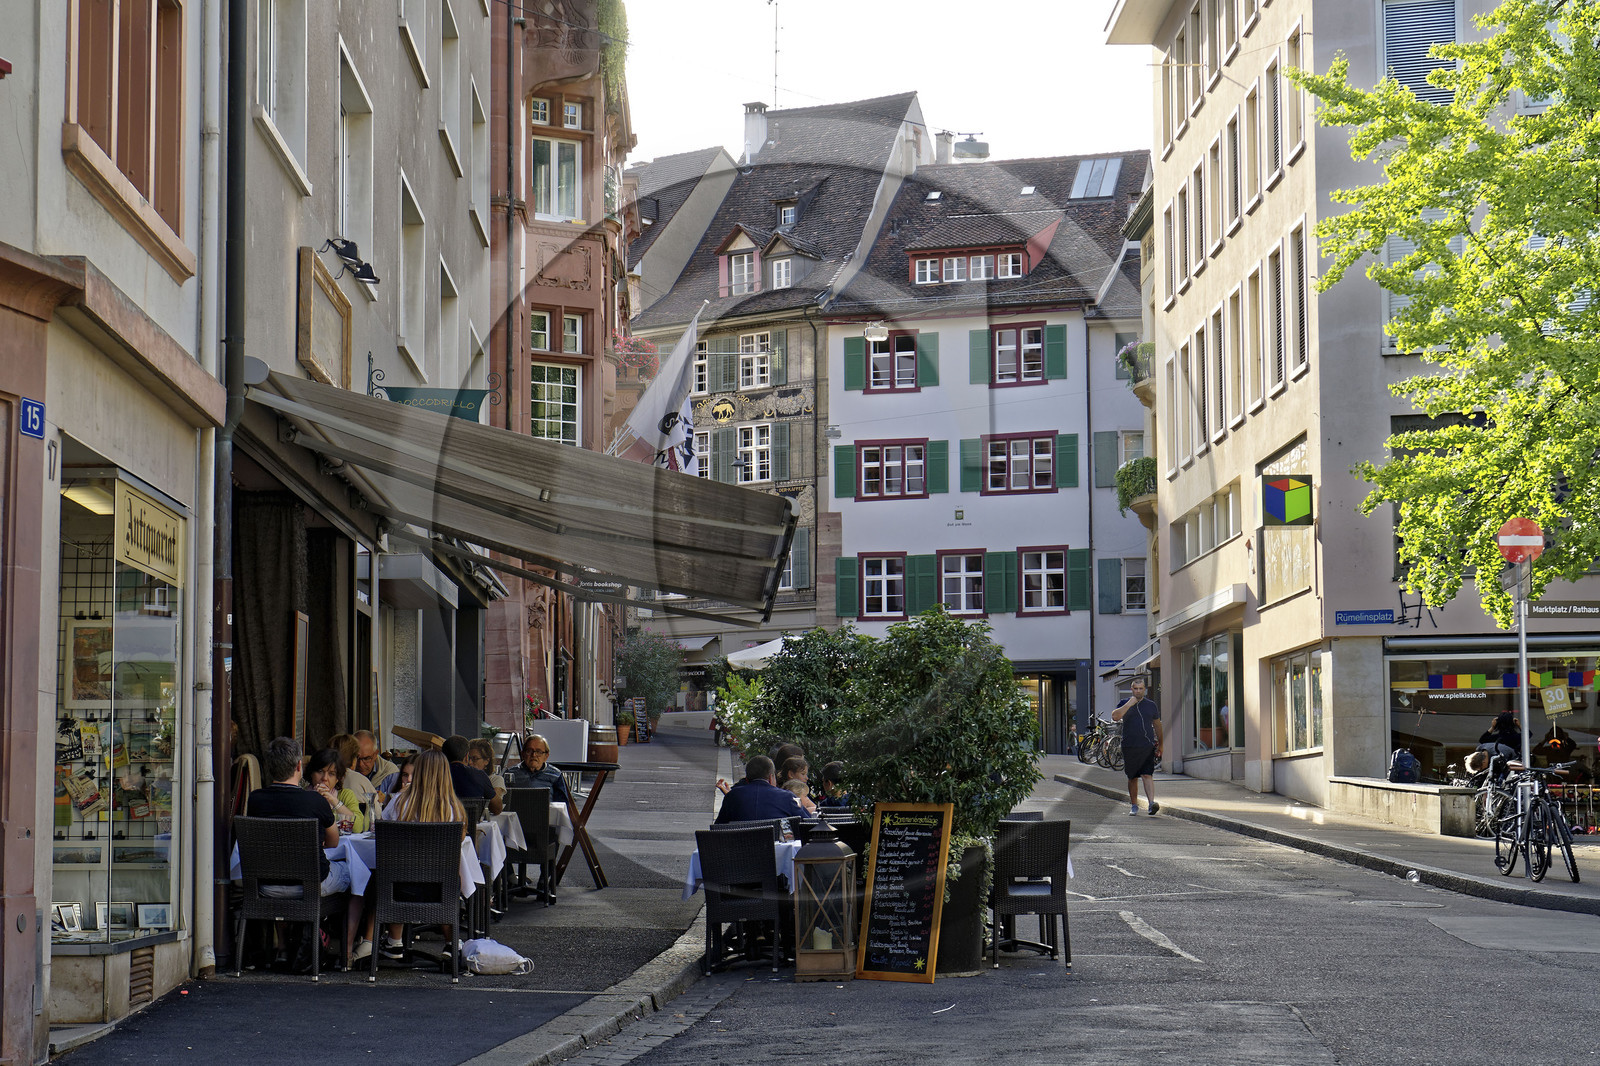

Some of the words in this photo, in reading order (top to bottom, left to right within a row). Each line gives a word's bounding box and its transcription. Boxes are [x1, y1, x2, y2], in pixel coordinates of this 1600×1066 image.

[27, 405, 40, 431] 15
[125, 497, 176, 567] Antiquariat
[1532, 605, 1567, 614] Marktplatz
[1573, 605, 1600, 614] Rathaus
[1336, 612, 1393, 623] Rümelinsplatz
[1428, 692, 1487, 700] www.spielkiste.ch
[1545, 687, 1565, 703] 30
[1548, 702, 1567, 711] Jahre
[1561, 710, 1574, 718] 2014
